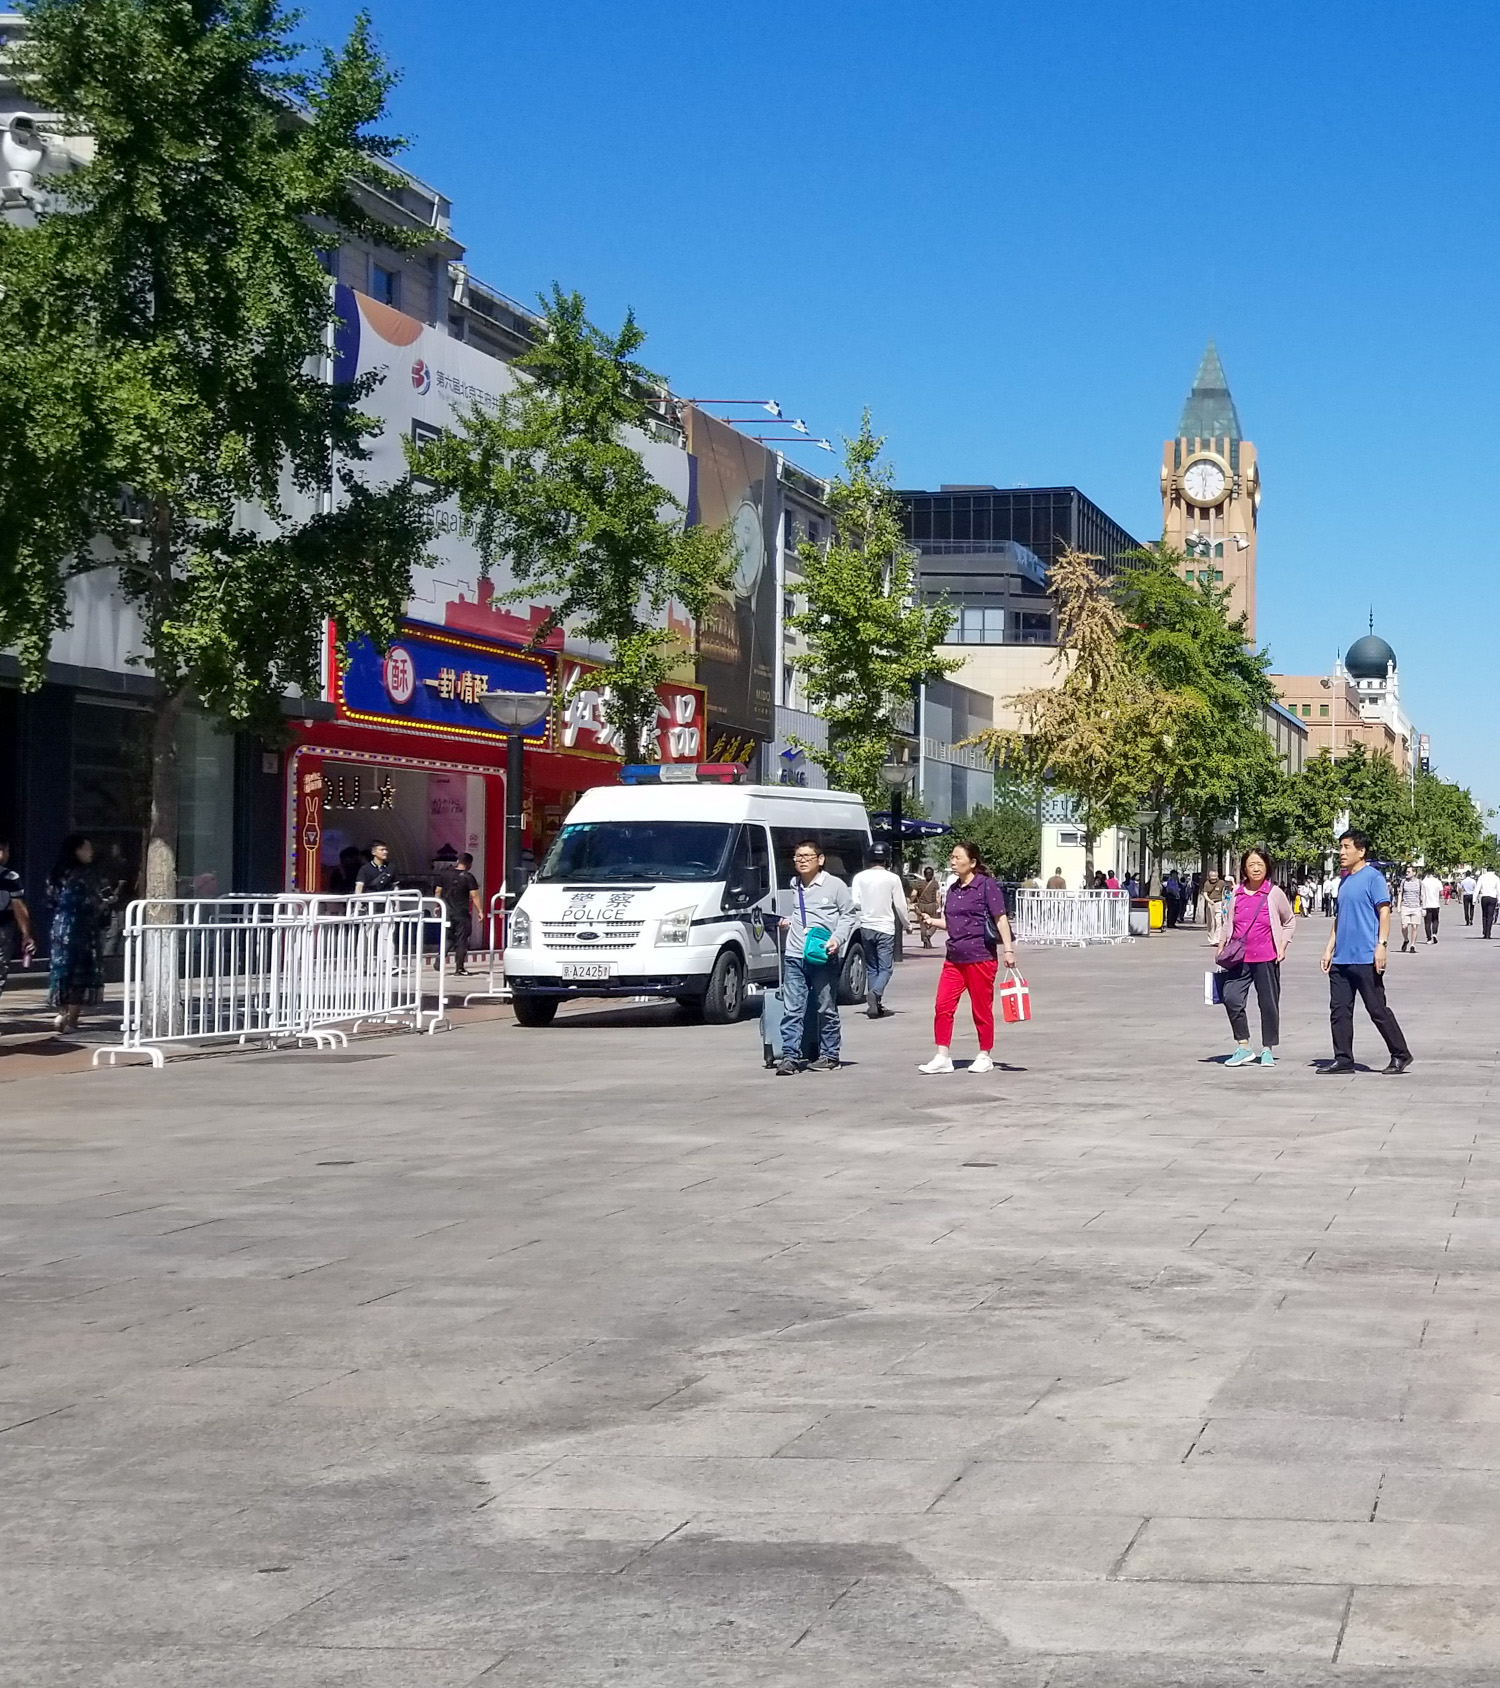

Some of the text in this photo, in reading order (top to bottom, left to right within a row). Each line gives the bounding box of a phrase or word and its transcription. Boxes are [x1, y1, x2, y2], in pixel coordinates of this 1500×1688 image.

[391, 658, 408, 692] 酥
[568, 893, 636, 909] 警察
[561, 908, 626, 921] POLICE
